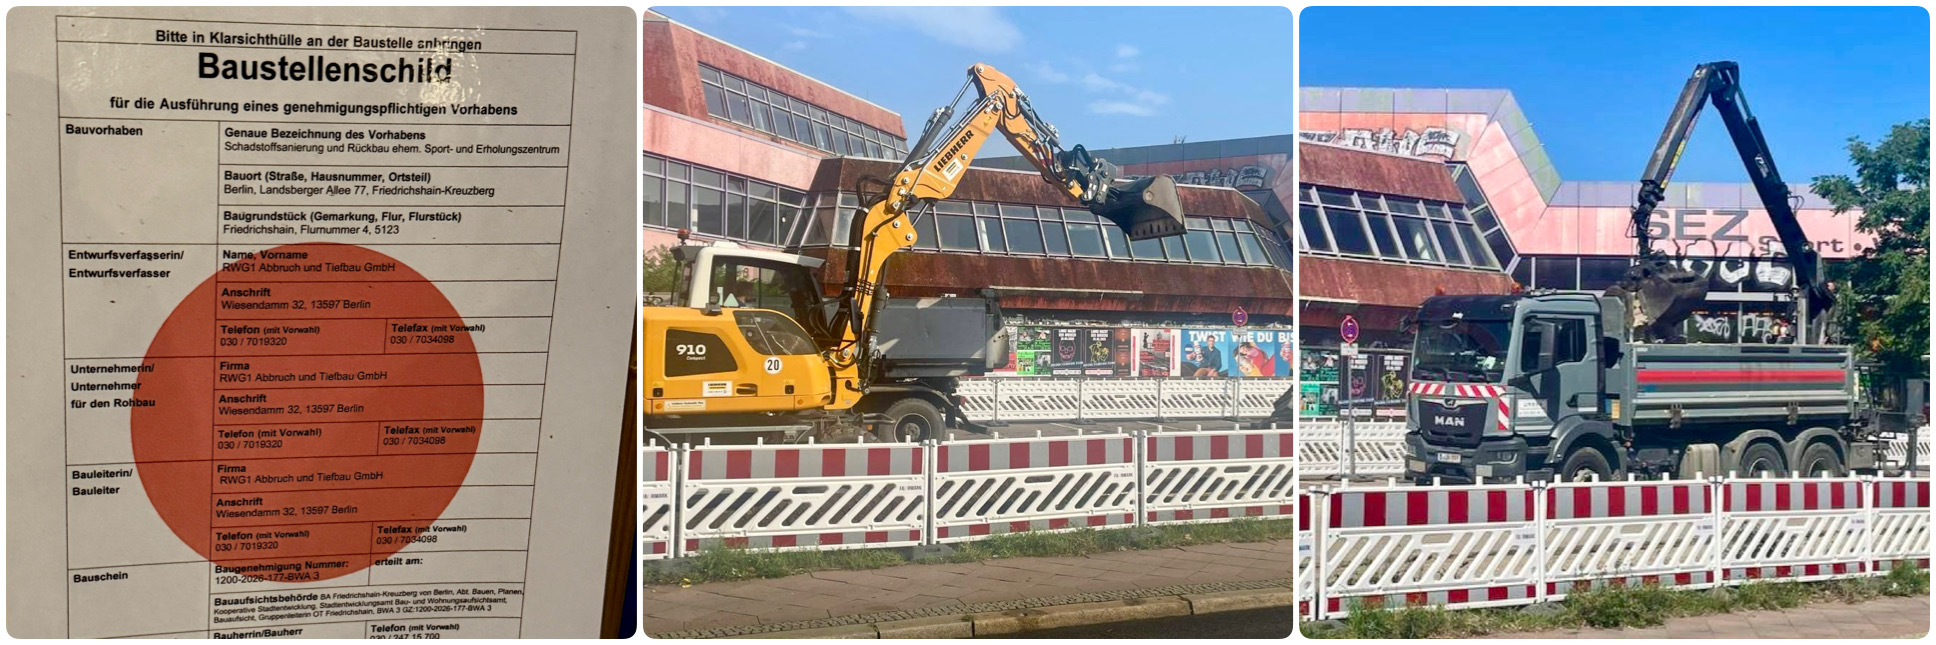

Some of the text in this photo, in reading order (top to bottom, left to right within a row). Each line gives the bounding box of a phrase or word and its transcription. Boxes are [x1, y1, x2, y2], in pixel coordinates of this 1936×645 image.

[156, 29, 482, 52] Bitte in Klarsichthülle an der Baustelle anbringen
[198, 52, 452, 83] Baustellenschild
[110, 96, 517, 117] für die Ausführung eines genehmigungspflichtigen Vorhabens
[65, 124, 142, 135] Bauvorhaben
[224, 128, 425, 142] Genaue Bezeichnung des Vorhabens
[224, 141, 559, 155] Schadstoffsanierung und Rückbau ehem. Sport- und Erholungszentrum
[933, 130, 974, 172] LIEBHERR
[224, 170, 430, 183] Bauort (Straße, Hausnummer, Ortsteil)
[224, 184, 494, 197] Berlin, Landsberger Allee 77, Friedrichshain-Kreuzberg
[223, 211, 461, 223] Baugrundstück (Gemarkung, Flur, Flurstück)
[223, 224, 399, 234] Friedrichshain, Flurnummer 4, 5123
[1648, 209, 1749, 241] SEZ
[68, 250, 184, 260] Entwurfsverfasserin/
[222, 250, 308, 262] Name, Vorname
[222, 262, 395, 272] RWG1 Abbruch und Tiefbau GmbH
[69, 268, 170, 277] Entwurfsverfasser
[221, 288, 270, 296] Anschrift
[221, 300, 288, 309] Wiesendamm
[311, 300, 340, 308] 13597
[342, 300, 370, 308] Berlin
[220, 325, 320, 334] Telefon Vorwahl)
[391, 323, 485, 332] Telefax Vorwahl)
[220, 337, 287, 346] 030 7019320
[390, 335, 454, 344] 030 7034098
[1188, 331, 1226, 342] TWIST
[1257, 331, 1274, 343] DU
[676, 344, 706, 355] 910
[70, 363, 154, 373] Unternehmerin/
[220, 361, 249, 370] Firma
[767, 359, 780, 371] 20
[219, 371, 387, 382] RWG1 Abbruch und Tiefbau GmbH
[71, 381, 141, 391] Unternehmer
[70, 398, 155, 408] für den Rohbau
[218, 394, 266, 403] Anschrift
[218, 406, 284, 415] Wiesendamm
[306, 404, 334, 413] 13597
[336, 404, 364, 412] Berlin
[1434, 415, 1465, 427] MAN
[218, 428, 321, 438] Telefon (mit Vorwahl)
[384, 425, 419, 434] Telefax
[217, 439, 282, 449] 030 7019320
[382, 436, 445, 445] 030 7034098
[217, 464, 246, 472] Firma
[72, 468, 132, 479] Bauleiterin/
[219, 471, 382, 484] RWG1 Abbruch und Tiefbau GmbH
[72, 486, 120, 495] Bauleiter
[216, 497, 262, 506] Anschrift
[216, 508, 280, 517] Wiesendamm
[301, 505, 329, 514] 13597
[331, 505, 357, 514] Berlin
[216, 530, 309, 540] Telefon Vorwahl)
[377, 526, 412, 534] Telefax
[415, 526, 430, 534] (mit
[376, 534, 437, 544] 030 7034098
[215, 541, 278, 550] 030 7019320
[375, 557, 402, 566] erteilt
[215, 560, 348, 575] Baugenehmigung Nummer:
[73, 571, 128, 582] Bauschein
[216, 572, 310, 584] 1200-2026-177-BWA
[214, 594, 318, 606] Bauaufsichtsbehörde
[370, 623, 405, 632] Telefon
[408, 624, 423, 632] (mit
[214, 628, 303, 638] Bauherrin/Bauherr
